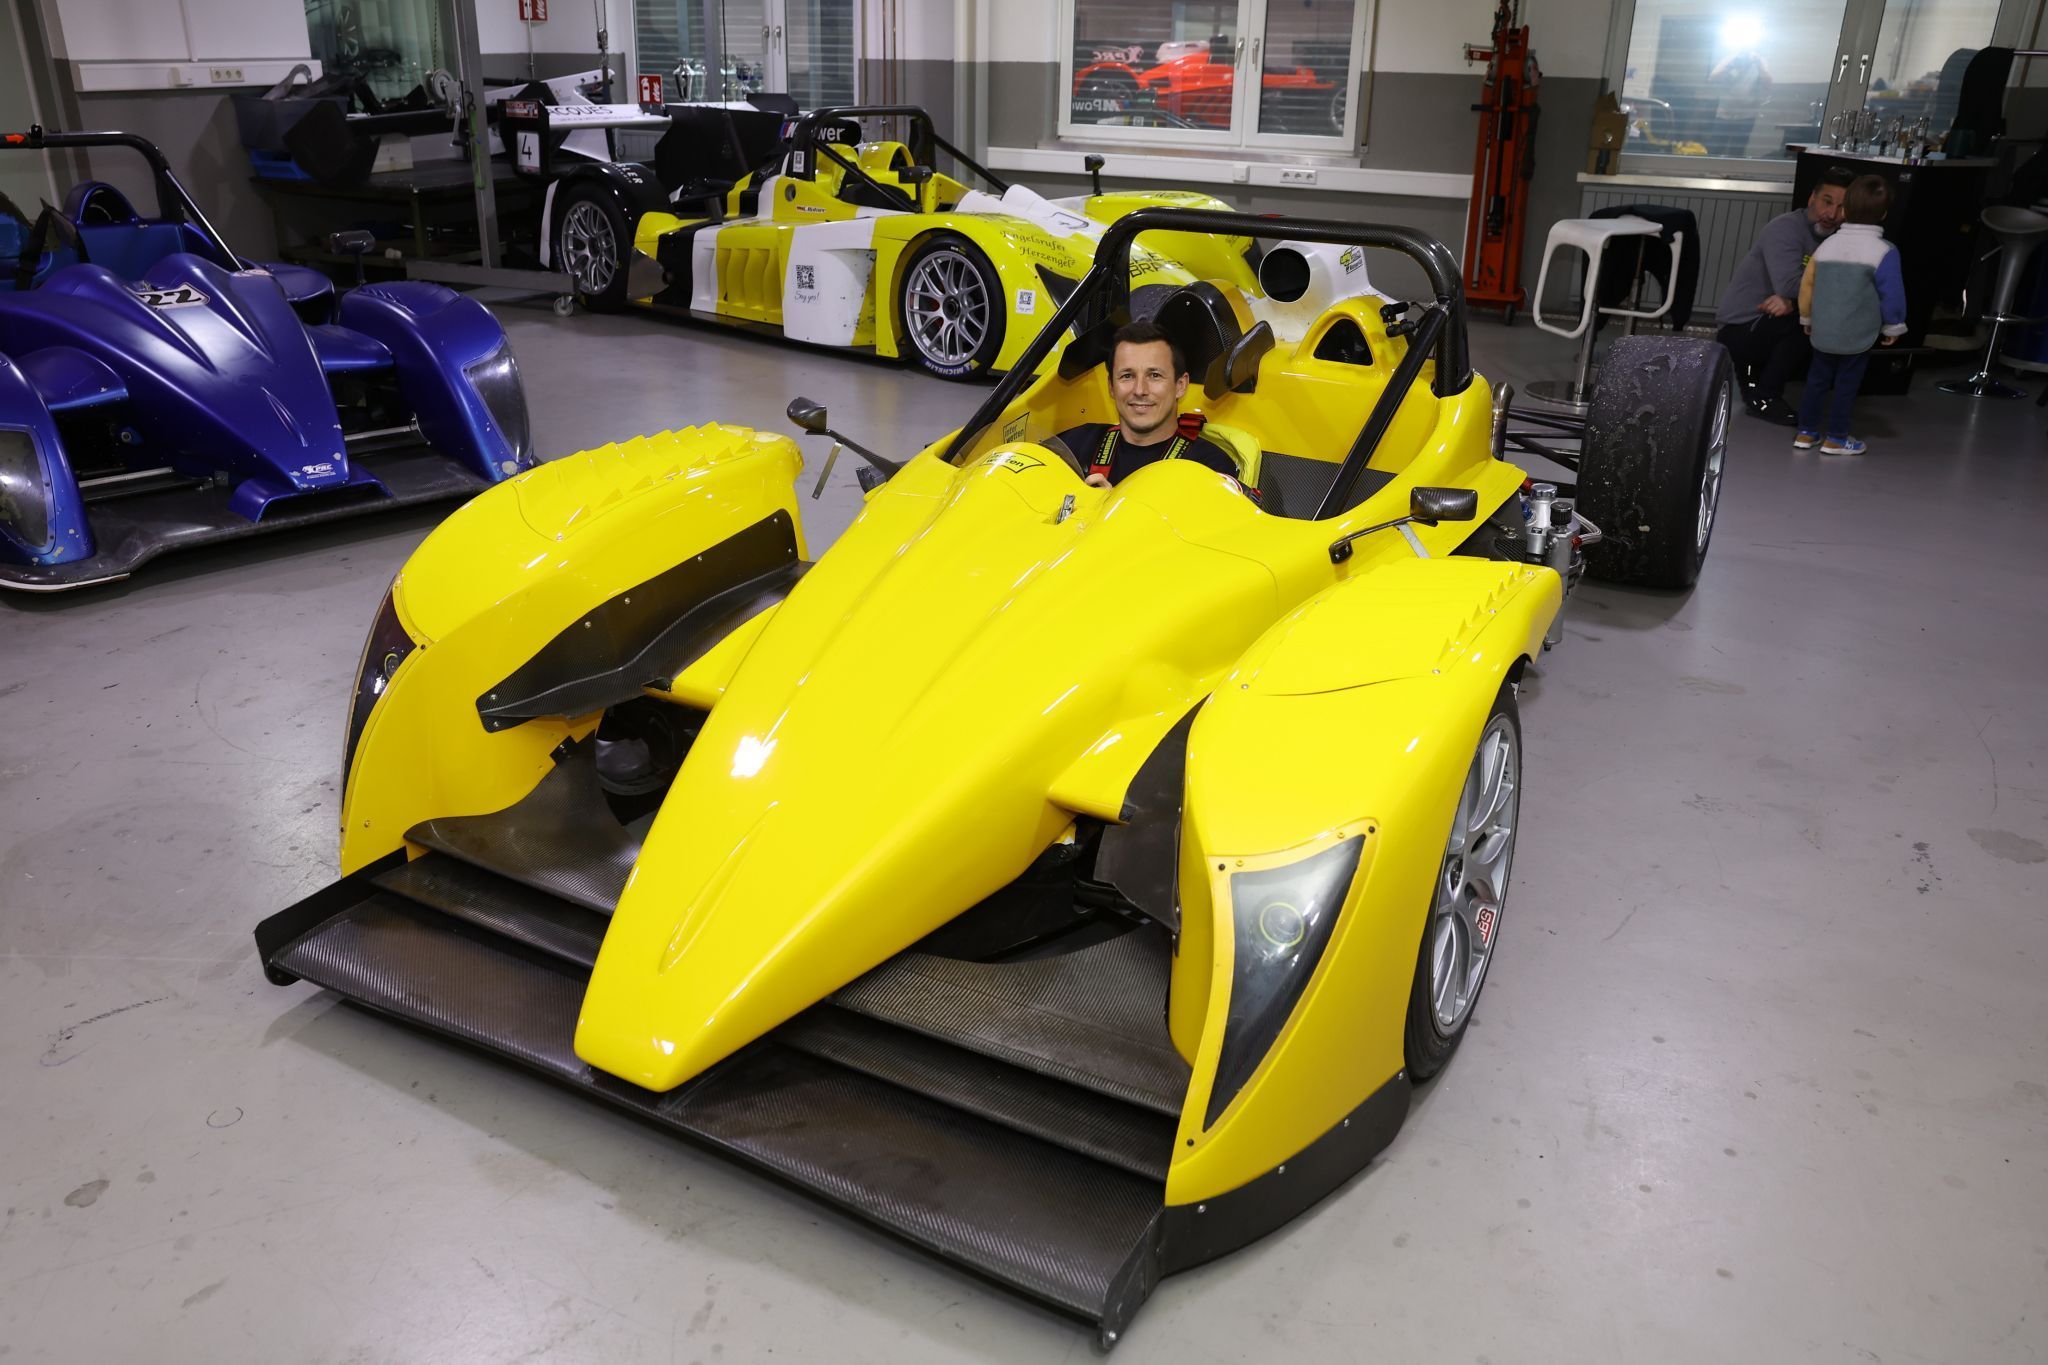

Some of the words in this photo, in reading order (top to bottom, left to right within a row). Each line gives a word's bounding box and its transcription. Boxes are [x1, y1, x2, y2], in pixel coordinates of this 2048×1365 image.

[521, 134, 532, 160] 4
[139, 289, 203, 307] 22
[925, 361, 964, 375] MICHELIN
